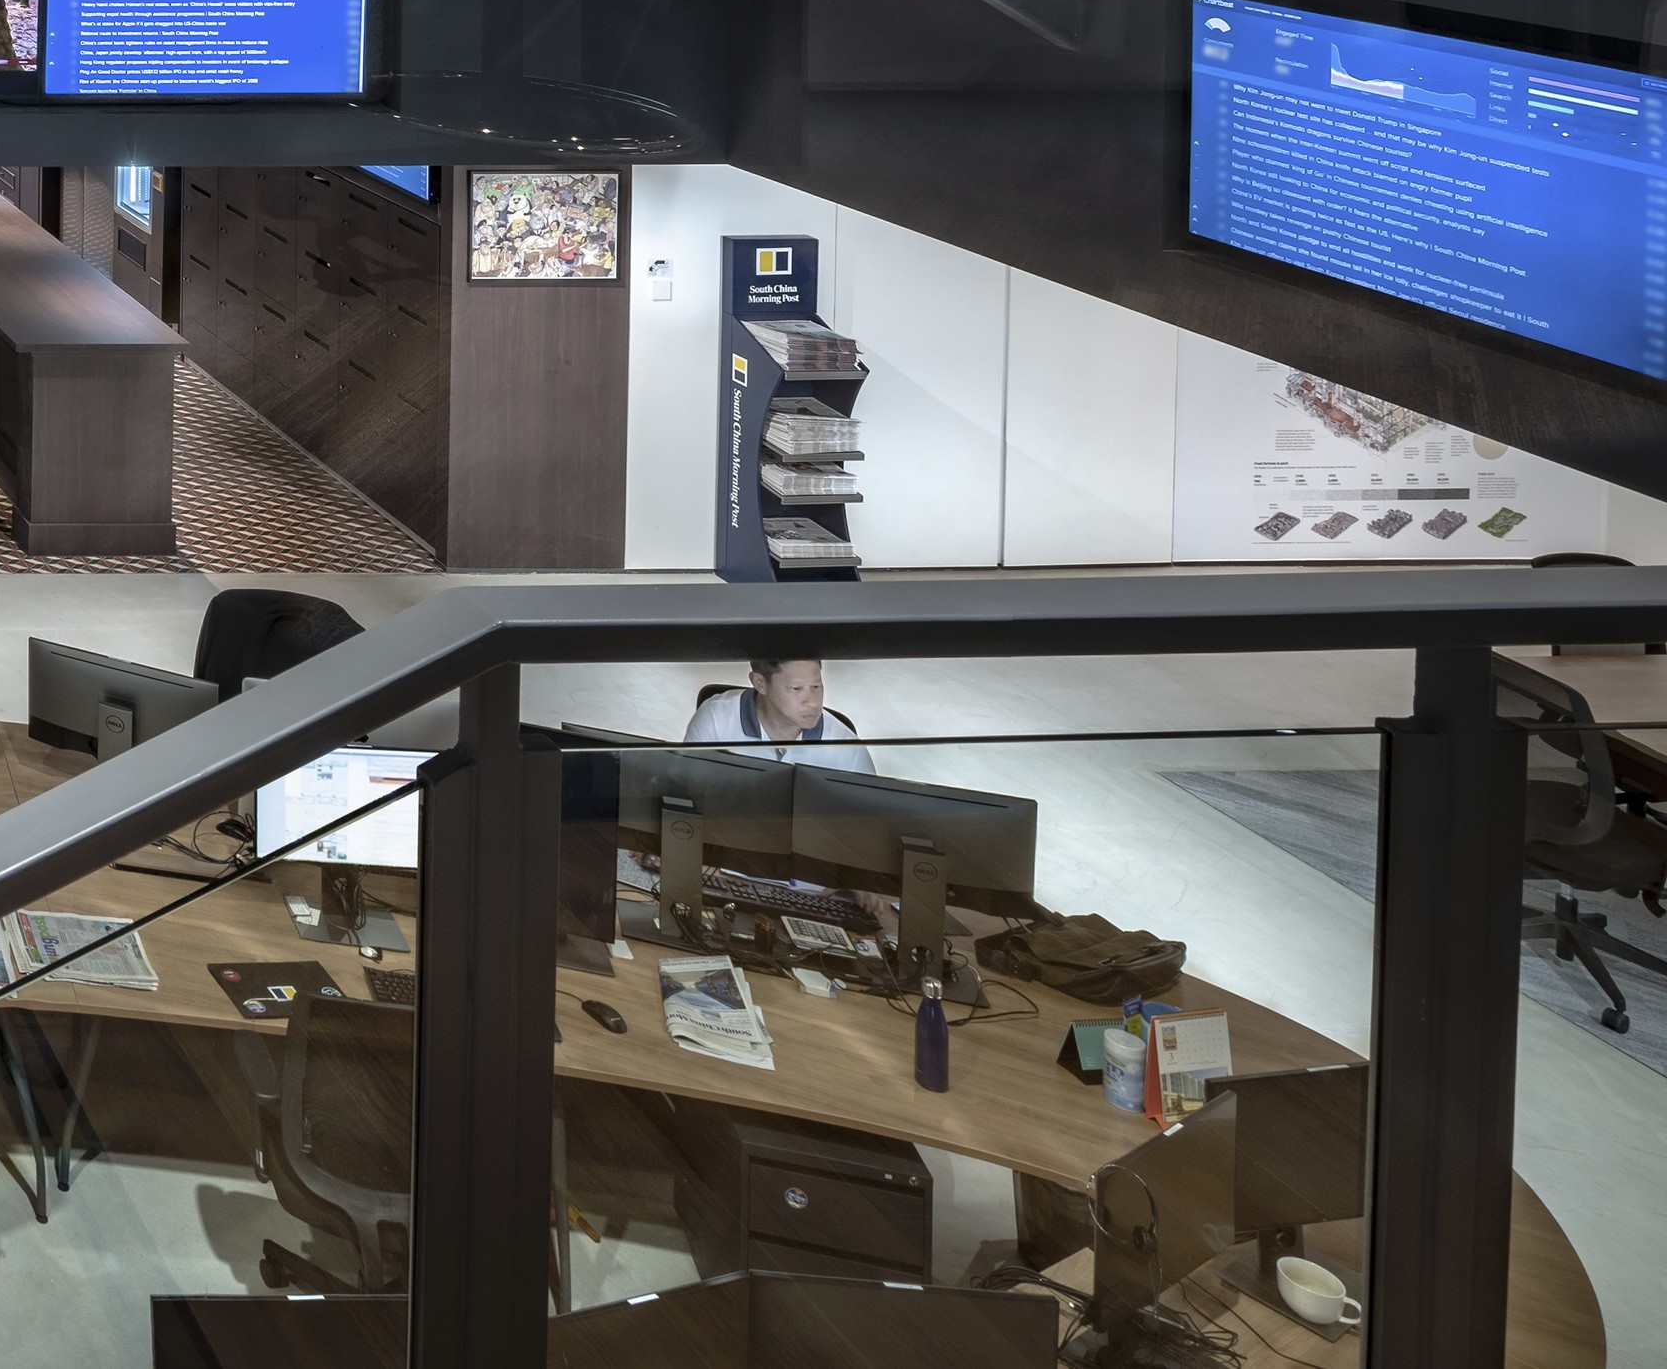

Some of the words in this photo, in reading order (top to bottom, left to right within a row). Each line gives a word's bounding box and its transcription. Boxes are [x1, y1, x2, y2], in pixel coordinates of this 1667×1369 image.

[1276, 28, 1300, 39] Engaged
[1300, 33, 1314, 41] Time
[1489, 67, 1509, 77] Social
[1489, 91, 1512, 101] Search
[749, 285, 773, 294] South
[773, 284, 798, 293] China
[748, 294, 782, 304] Morning
[782, 294, 800, 302] Post
[733, 388, 743, 421] South
[732, 421, 742, 456] China
[730, 456, 742, 503] Morning
[731, 503, 740, 528] Post
[107, 720, 122, 728] DELL
[690, 1017, 717, 1030] China
[721, 1026, 752, 1037] South
